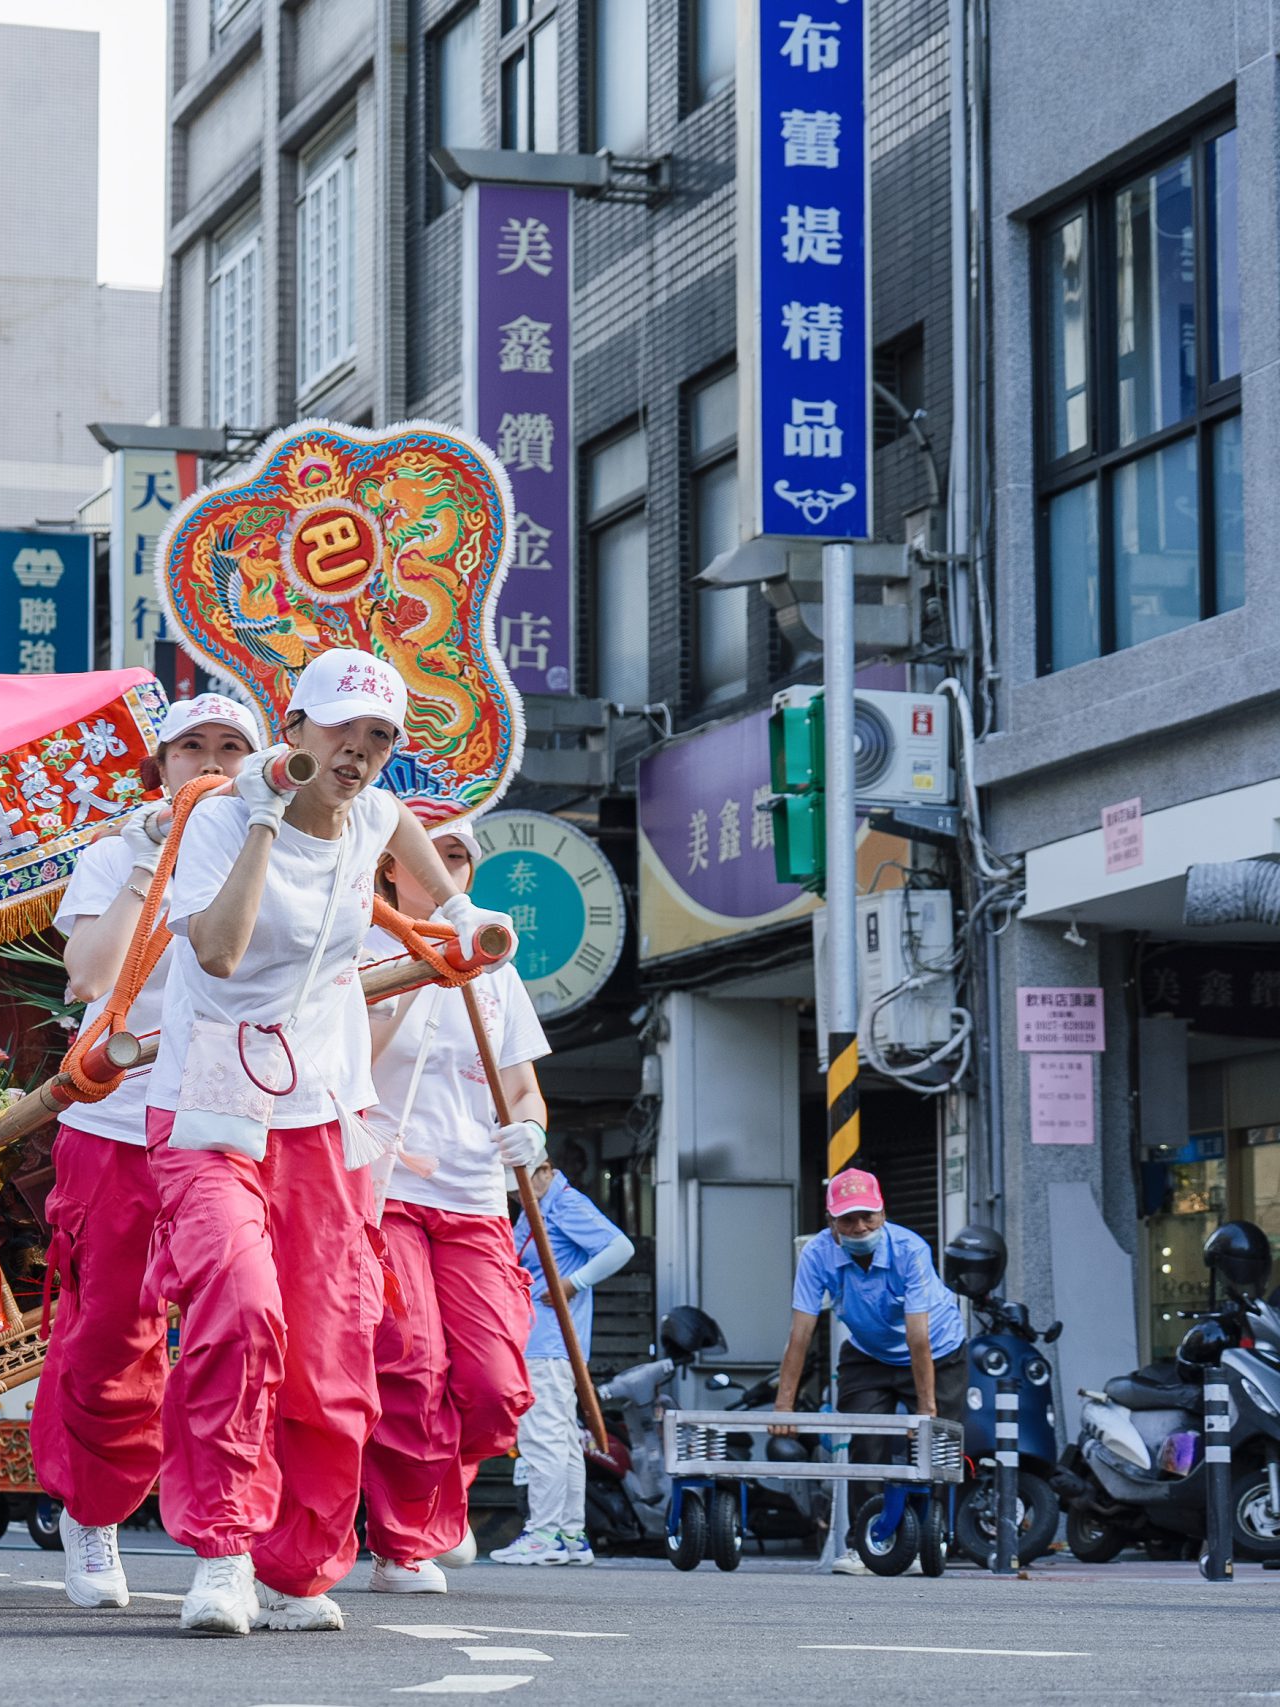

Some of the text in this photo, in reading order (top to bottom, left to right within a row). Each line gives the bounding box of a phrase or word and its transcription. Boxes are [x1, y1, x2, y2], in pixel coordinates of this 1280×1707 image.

[778, 13, 844, 459] 布蕾提精品
[497, 217, 555, 672] 美鑫鑽金店
[19, 597, 57, 673] 聯強
[506, 859, 538, 941] 泰興
